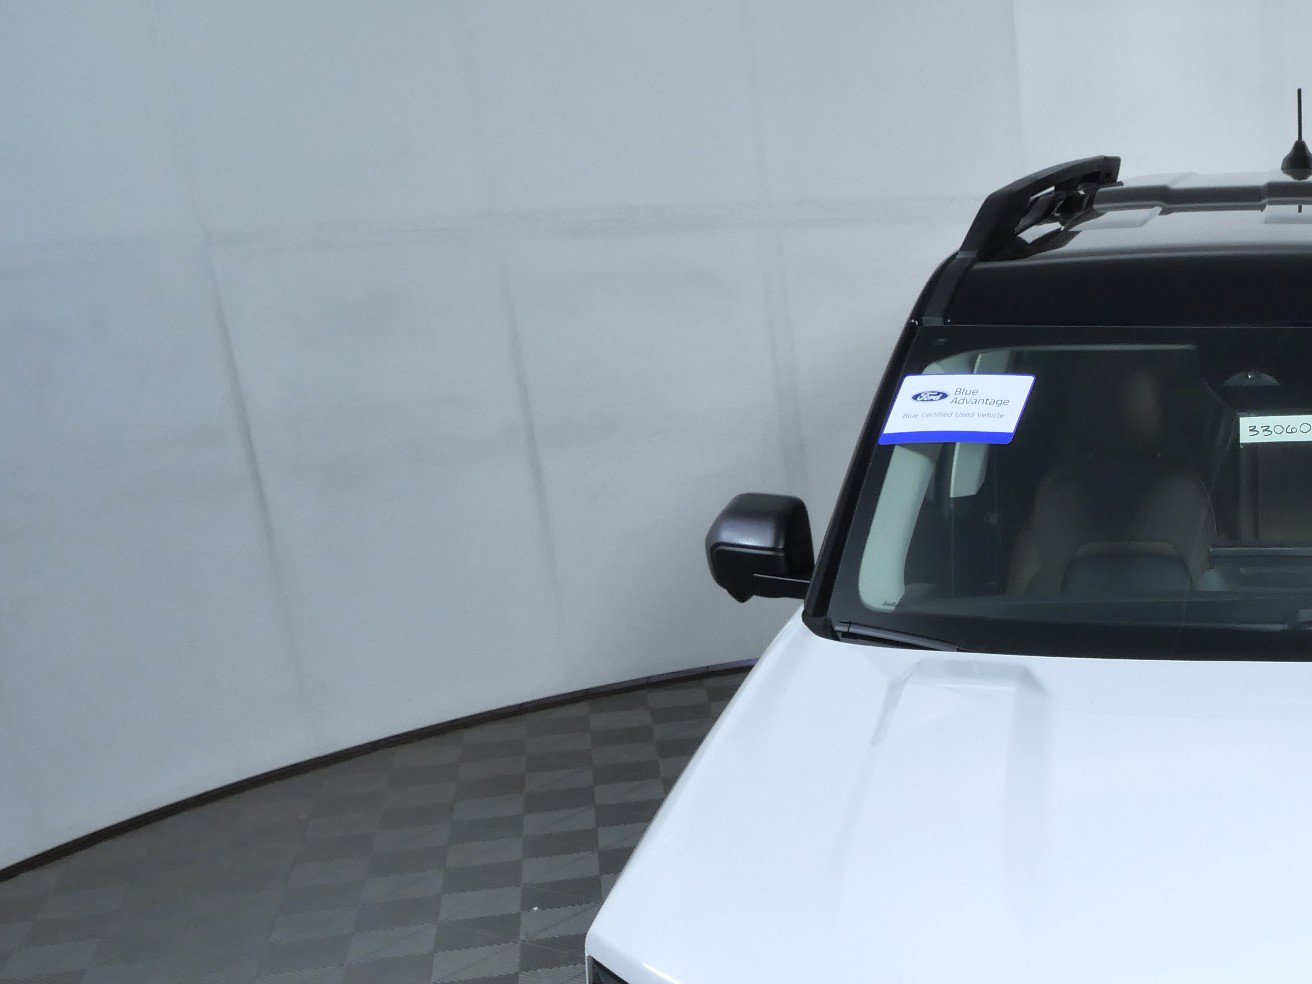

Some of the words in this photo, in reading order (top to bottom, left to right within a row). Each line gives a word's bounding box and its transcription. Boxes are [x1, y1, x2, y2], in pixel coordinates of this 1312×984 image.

[916, 390, 944, 402] Ford
[953, 387, 979, 396] Blue
[950, 397, 1010, 407] Advantage
[921, 411, 953, 419] Certified
